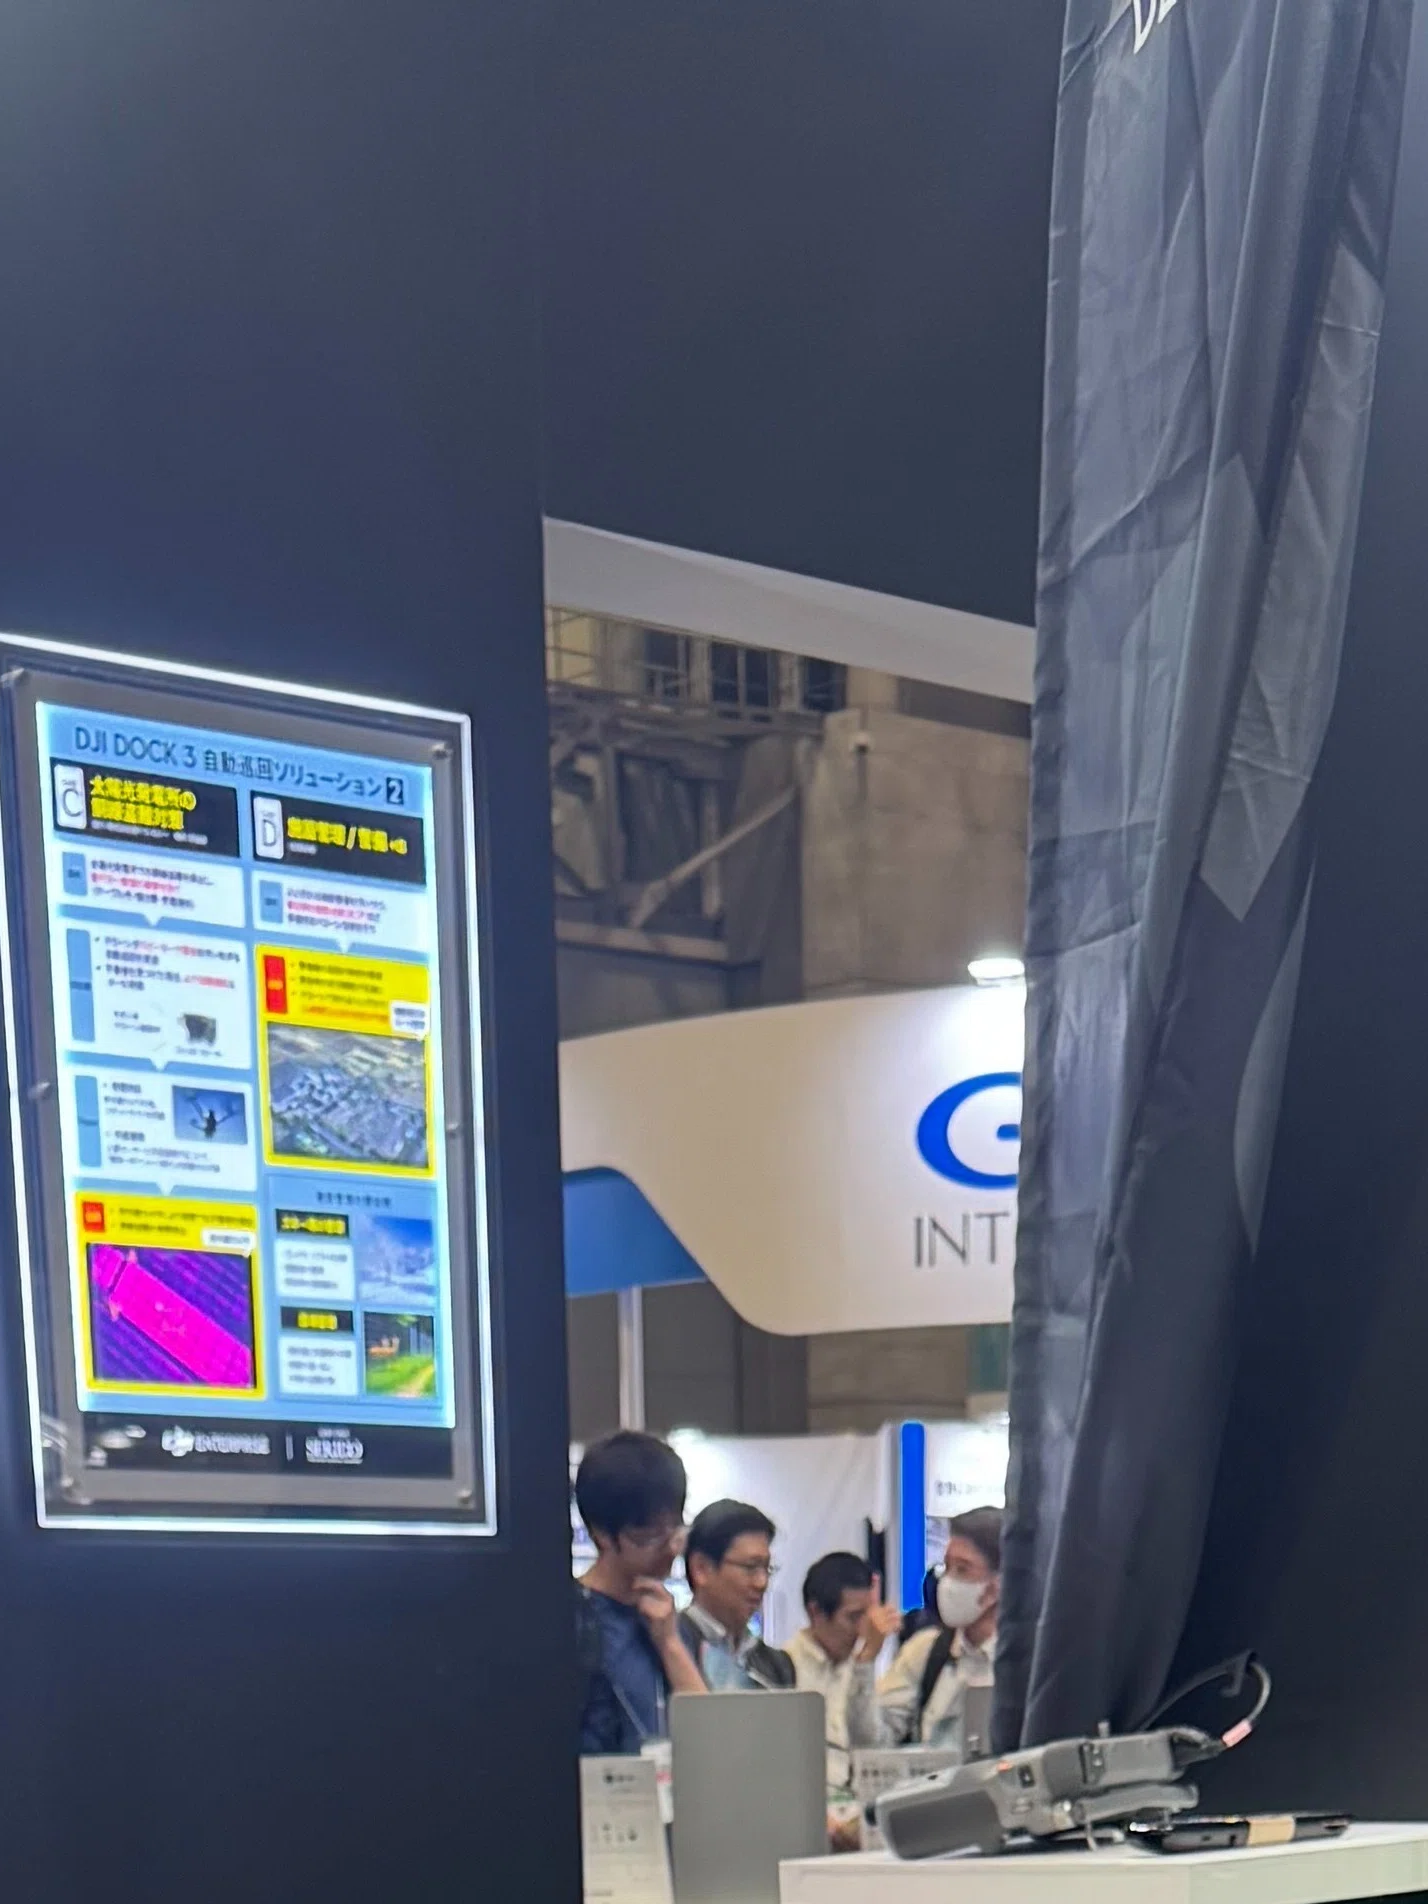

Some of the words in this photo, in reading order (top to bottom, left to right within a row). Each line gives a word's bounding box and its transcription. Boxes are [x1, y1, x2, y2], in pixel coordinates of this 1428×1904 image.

[75, 727, 107, 753] DJI
[114, 733, 178, 766] DOCK
[183, 745, 197, 768] 3
[63, 788, 82, 817] C
[262, 819, 278, 847] D
